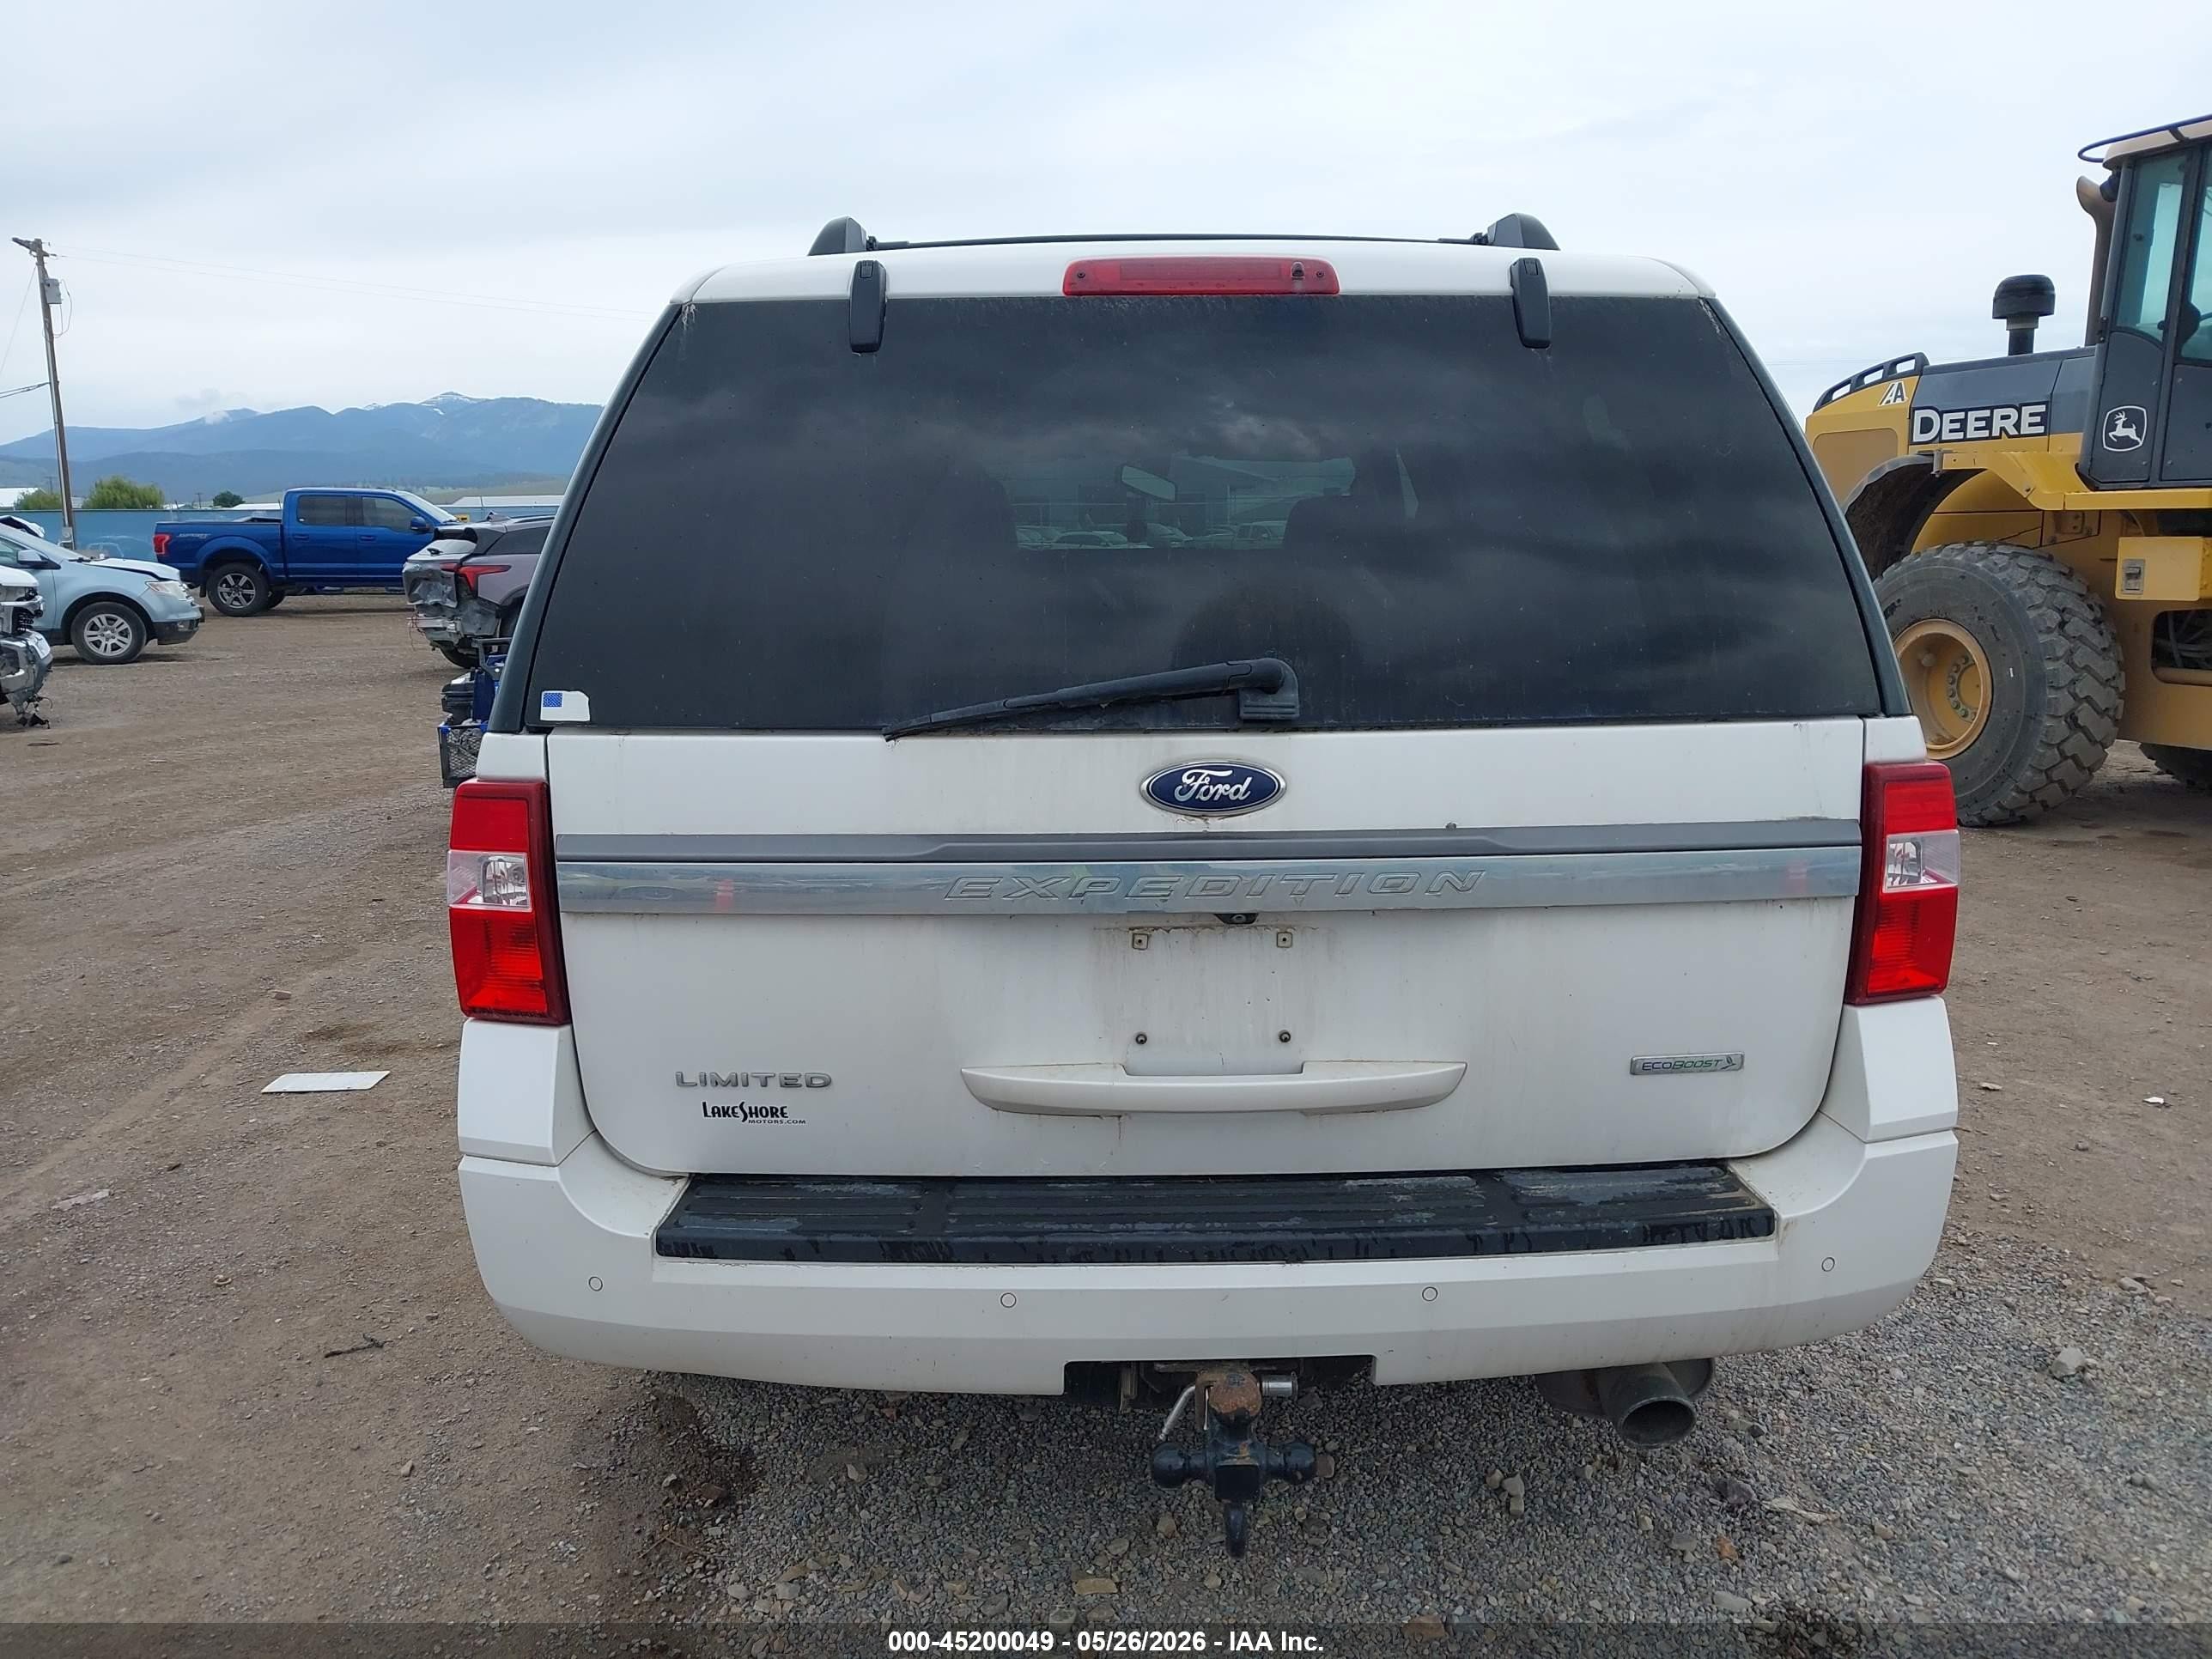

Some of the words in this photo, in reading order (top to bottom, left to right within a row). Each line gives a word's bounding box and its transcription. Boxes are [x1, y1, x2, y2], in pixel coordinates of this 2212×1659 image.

[1912, 404, 2047, 443] DEERE
[1173, 769, 1253, 802] Ford
[944, 869, 1486, 901] EXPEDITION
[674, 1071, 832, 1088] LIMITED
